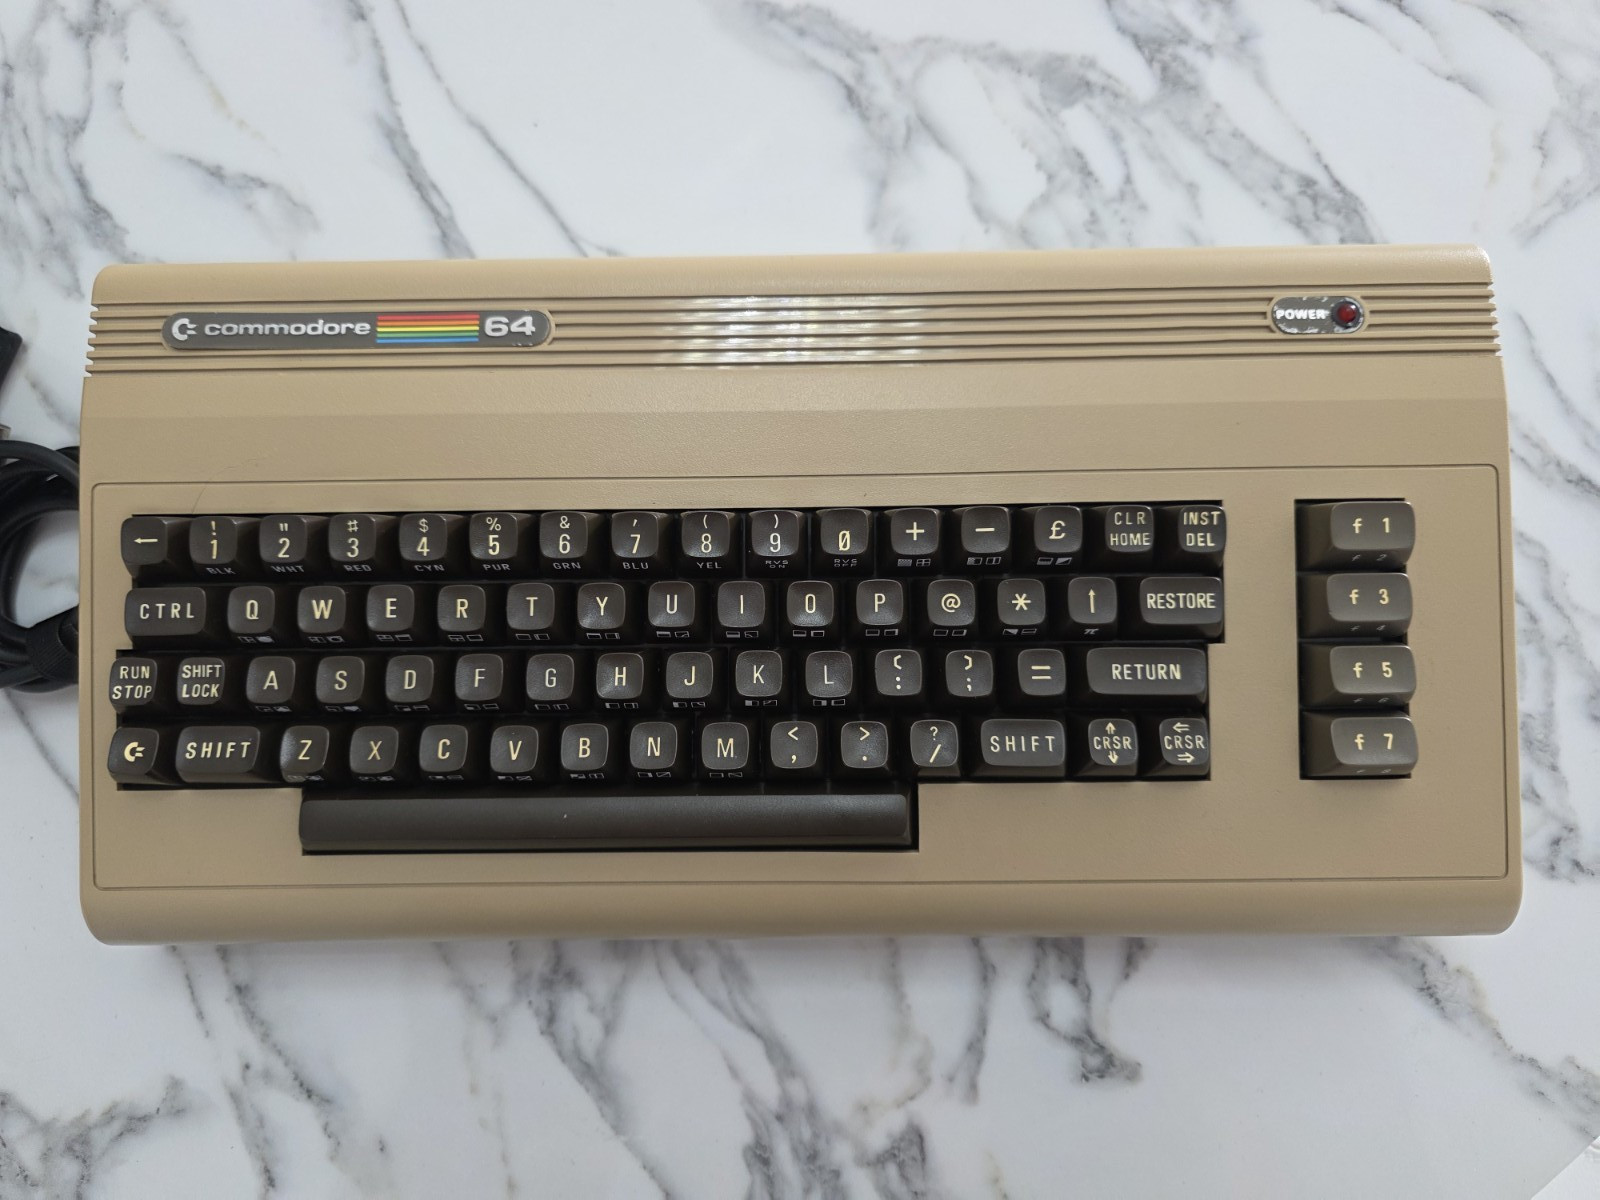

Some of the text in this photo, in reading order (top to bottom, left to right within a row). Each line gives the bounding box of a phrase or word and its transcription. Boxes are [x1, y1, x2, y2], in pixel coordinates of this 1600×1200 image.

[1276, 308, 1327, 320] POWER
[204, 316, 535, 337] commodore 64
[347, 520, 358, 532] #
[419, 518, 428, 532] $
[486, 517, 502, 531] %
[559, 516, 570, 528] &
[703, 514, 708, 528] (
[774, 514, 779, 528] )
[1114, 512, 1146, 525] CLR
[1184, 512, 1220, 525] INST
[1352, 518, 1390, 534] f 1
[1049, 520, 1066, 540] £
[1110, 532, 1150, 546] HOME
[1186, 533, 1215, 546] DEL
[210, 540, 217, 559] 1
[278, 538, 290, 558] 2
[346, 538, 359, 558] 3
[416, 536, 430, 556] 4
[488, 534, 500, 556] 5
[559, 534, 570, 554] 6
[630, 534, 641, 554] 7
[701, 534, 712, 552] 8
[770, 533, 781, 552] 9
[206, 567, 235, 575] BLK
[666, 594, 678, 614] U
[874, 594, 886, 612] P
[941, 593, 961, 612] @
[1147, 593, 1215, 608] RESTORE
[1349, 588, 1389, 604] f 3
[140, 604, 194, 619] CTRL
[246, 600, 258, 620] Q
[312, 600, 333, 619] W
[386, 598, 397, 618] E
[456, 599, 468, 618] R
[526, 597, 538, 616] T
[596, 596, 608, 616] Y
[120, 666, 150, 679] RUN
[182, 665, 222, 678] SHIFT
[404, 670, 416, 689] D
[474, 668, 486, 688] F
[545, 668, 557, 688] G
[614, 667, 626, 686] H
[684, 666, 696, 686] J
[753, 665, 764, 684] K
[824, 665, 834, 684] L
[1112, 664, 1182, 680] RETURN
[1353, 662, 1392, 678] f 5
[263, 670, 278, 690] A
[334, 671, 348, 690] S
[112, 686, 152, 699] STOP
[182, 684, 219, 698] LOCK
[930, 726, 938, 740] ?
[1354, 733, 1394, 750] f 7
[185, 742, 252, 759] SHIFT
[298, 740, 312, 760] Z
[368, 741, 382, 760] X
[437, 739, 450, 759] C
[509, 740, 522, 760] V
[578, 738, 590, 758] B
[648, 737, 660, 756] N
[717, 738, 734, 758] M
[990, 736, 1055, 752] SHIFT
[1093, 736, 1132, 750] CRSR
[1164, 736, 1205, 750] CRSR
